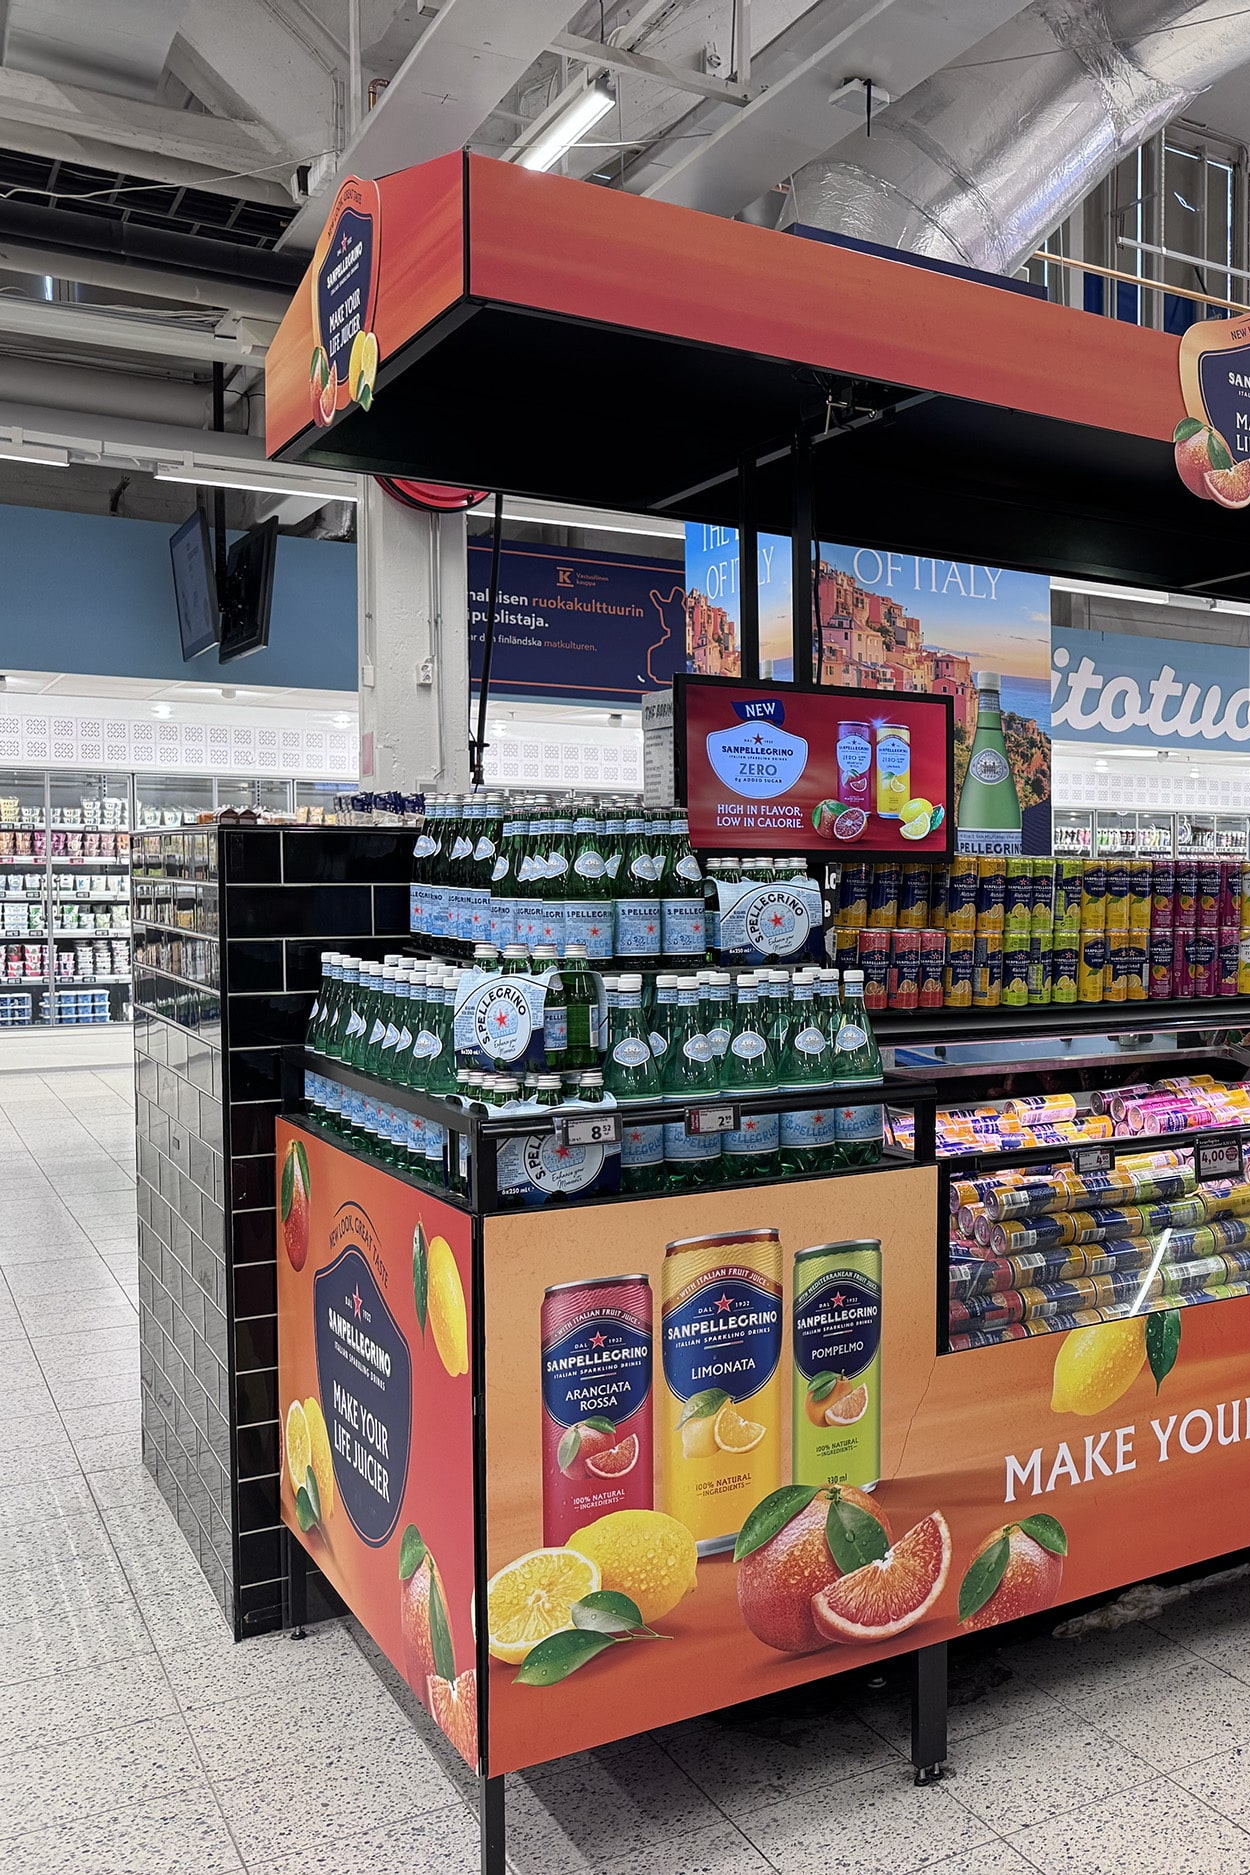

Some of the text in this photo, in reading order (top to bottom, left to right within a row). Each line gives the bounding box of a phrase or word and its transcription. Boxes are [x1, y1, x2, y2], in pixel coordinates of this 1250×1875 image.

[329, 288, 361, 333] MAKE YOUR
[1230, 329, 1247, 341] NEW
[329, 335, 340, 358] LIFE
[706, 562, 727, 600] OF
[853, 549, 1002, 600] OF ITALY
[532, 595, 644, 617] ruokakulttuurin
[498, 634, 542, 647] finländska
[544, 640, 597, 651] matkulturen.
[745, 702, 775, 717] NEW
[722, 745, 794, 756] SANPELLEGRINO
[740, 763, 777, 776] ZERO
[717, 804, 803, 817] HIGH IN FLAVOR,
[716, 816, 804, 828] LOW IN CALORIE.
[749, 893, 804, 944] S.PELLEGRINO
[477, 988, 527, 1045] S.PELLEGRINO
[718, 1116, 725, 1126] 2
[591, 1126, 602, 1140] 8
[1201, 1149, 1224, 1164] 4,00
[354, 1216, 373, 1251] GREAT
[372, 1244, 389, 1289] TASTE
[679, 1267, 767, 1300] WITH ITALIAN FRUIT JUICE
[808, 1271, 853, 1293] MEDITERRANEAN
[853, 1273, 867, 1284] FRUIT
[698, 1300, 750, 1314] DAL 1932
[557, 1308, 638, 1336] WITH ITALIAN FRUIT JUICE
[668, 1310, 778, 1339] SANPELLEGRINO
[797, 1305, 878, 1330] SANPELLEGRINO
[675, 1327, 771, 1348] ITALIAN SPARKLING DRINKS
[802, 1328, 821, 1336] ITALIAN
[823, 1322, 854, 1333] SPARKLING
[328, 1307, 392, 1378] SANPELLEGRINO
[608, 1336, 623, 1344] 1932
[547, 1346, 648, 1373] SANPELLEGRINO
[811, 1341, 864, 1360] POMPELMO
[554, 1360, 642, 1380] ITALIAN SPARKLING DRINKS
[691, 1358, 756, 1380] LIMONATA
[566, 1381, 632, 1401] ARANCIATA
[580, 1396, 618, 1411] ROSSA
[333, 1380, 390, 1461] MAKE YOUR
[815, 1437, 858, 1453] 100% NATURAL
[333, 1418, 390, 1503] LIFE JUICIER
[1004, 1424, 1138, 1503] MAKE
[695, 1472, 751, 1491] 100% NATURAL
[839, 1473, 848, 1483] ml
[573, 1488, 625, 1505] 100% NATURAL
[702, 1482, 745, 1497] INGREDIENTS
[580, 1497, 620, 1510] INGREDIENTS
